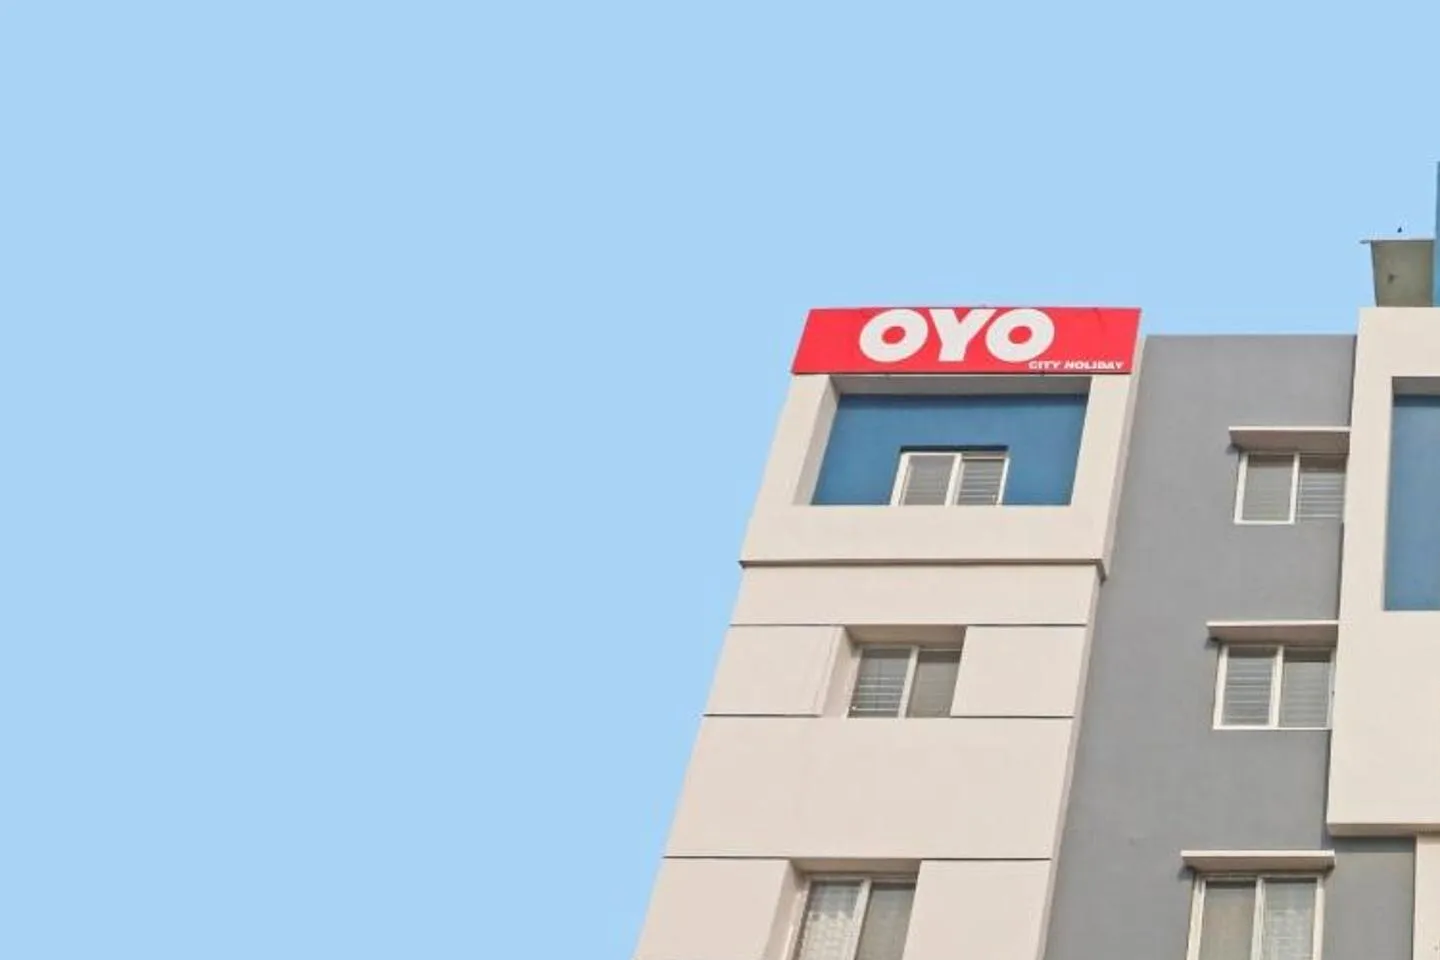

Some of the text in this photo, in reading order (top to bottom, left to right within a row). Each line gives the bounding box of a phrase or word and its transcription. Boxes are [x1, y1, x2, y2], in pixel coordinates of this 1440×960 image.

[859, 308, 1055, 362] OYO
[1028, 360, 1124, 370] CITY HOLIDAY
